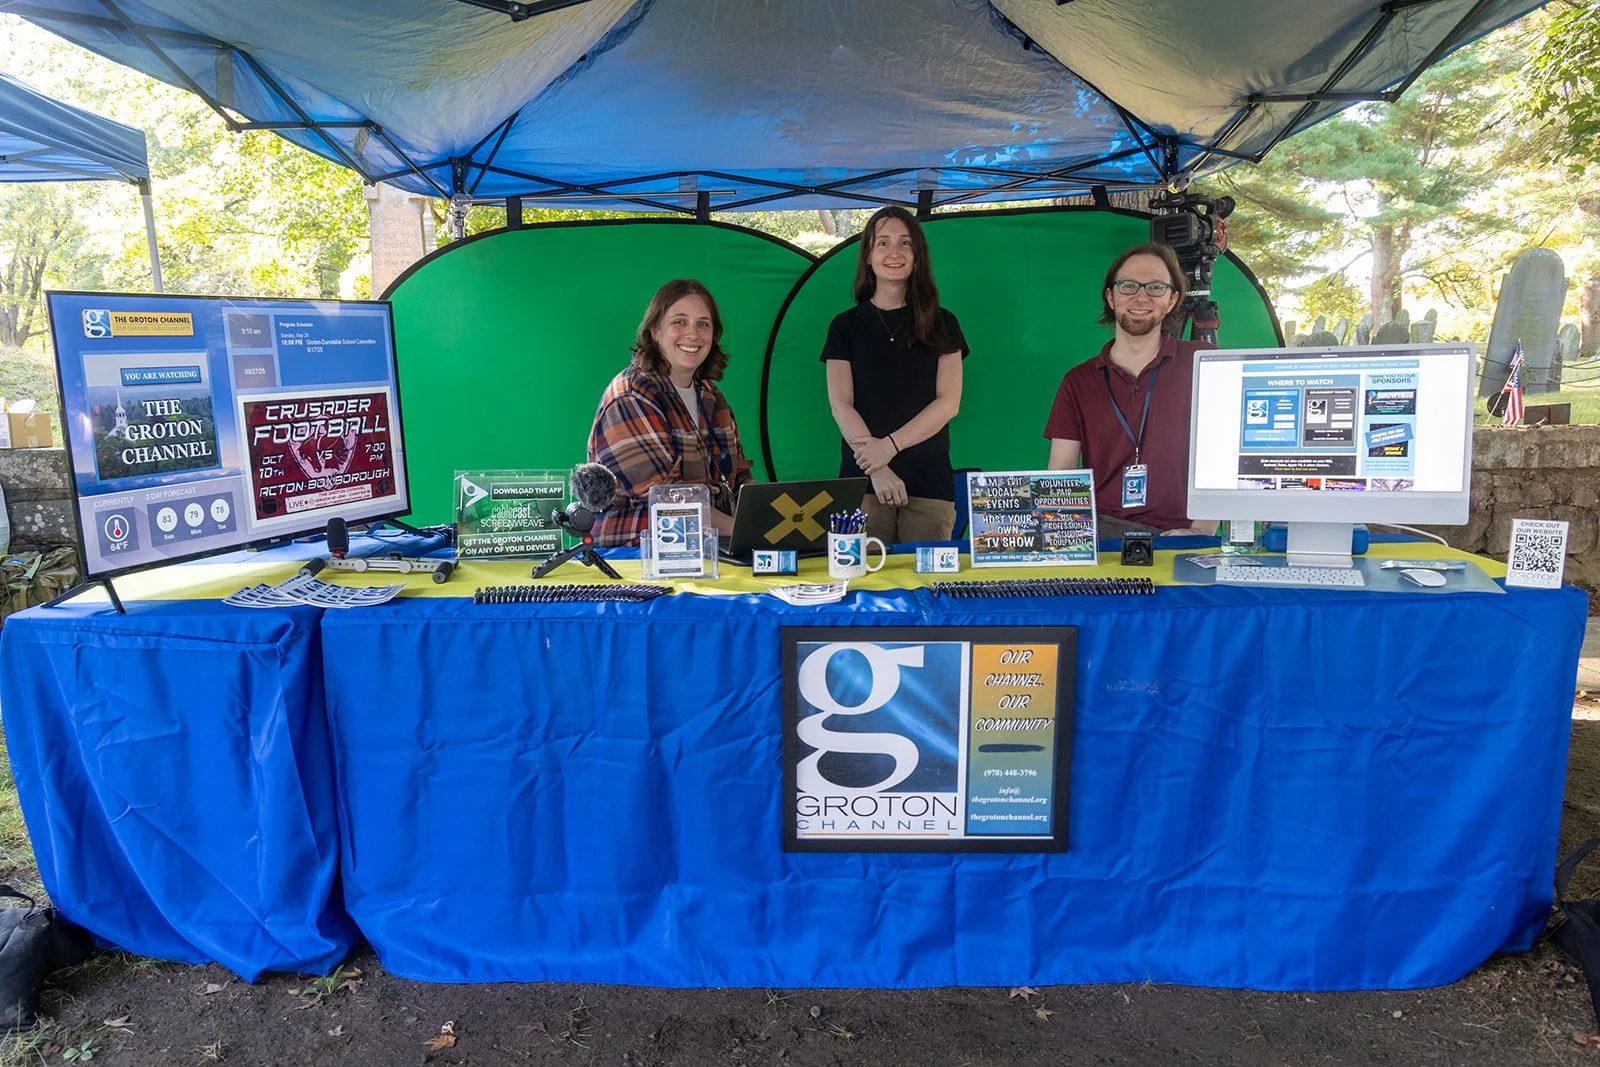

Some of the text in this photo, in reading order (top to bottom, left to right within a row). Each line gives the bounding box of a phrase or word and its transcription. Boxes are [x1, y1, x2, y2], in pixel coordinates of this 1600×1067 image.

[124, 372, 141, 380] YOU
[158, 370, 198, 378] WATCHING
[142, 399, 182, 417] THE
[266, 398, 371, 420] CRUSADER
[125, 420, 203, 442] GROTON
[254, 414, 387, 446] FOOTBALL
[121, 440, 212, 465] CHANNEL
[365, 442, 386, 453] 7:00
[262, 454, 284, 465] OCT
[316, 450, 333, 460] VS
[370, 454, 383, 462] PM
[259, 468, 390, 498] ACTON-BOXBOROUGH
[1040, 479, 1080, 488] VOLUNTEER
[151, 491, 164, 500] DAY
[164, 487, 196, 498] FORECAST
[493, 487, 534, 495] DOWNLOAD
[988, 488, 1016, 496] LOCAL
[94, 496, 134, 508] CURRENTLY
[288, 500, 305, 510] LIVE
[986, 498, 1020, 508] EVENTS
[1034, 497, 1089, 506] OPPORTUNITIES
[189, 510, 199, 519] 79
[215, 506, 224, 514] 78
[162, 515, 172, 524] 83
[480, 518, 545, 528] SCREENWEAVE
[982, 514, 1032, 524] HOST YOUR
[998, 525, 1018, 534] OWN
[1044, 522, 1090, 530] PROFESSIONAL
[492, 536, 523, 545] GROTON
[524, 534, 558, 542] CHANNEL
[984, 536, 1034, 548] TV SHOW
[110, 541, 129, 552] 64°F
[477, 546, 494, 554] ANY
[526, 544, 556, 552] DEVICES
[834, 538, 856, 566] g
[1000, 650, 1034, 664] OUR
[984, 673, 1044, 687] CHANNEL.
[998, 694, 1032, 710] OUR
[797, 642, 924, 793] g
[975, 717, 1054, 732] COMMUNITY
[984, 769, 1038, 778] (978) 448-3796
[998, 786, 1022, 796] info@
[971, 796, 1048, 805] thegrotonchannel.org
[796, 795, 958, 818] GROTON
[970, 814, 1048, 822] thegrotonchannel.org
[796, 820, 958, 830] CHANNEL
